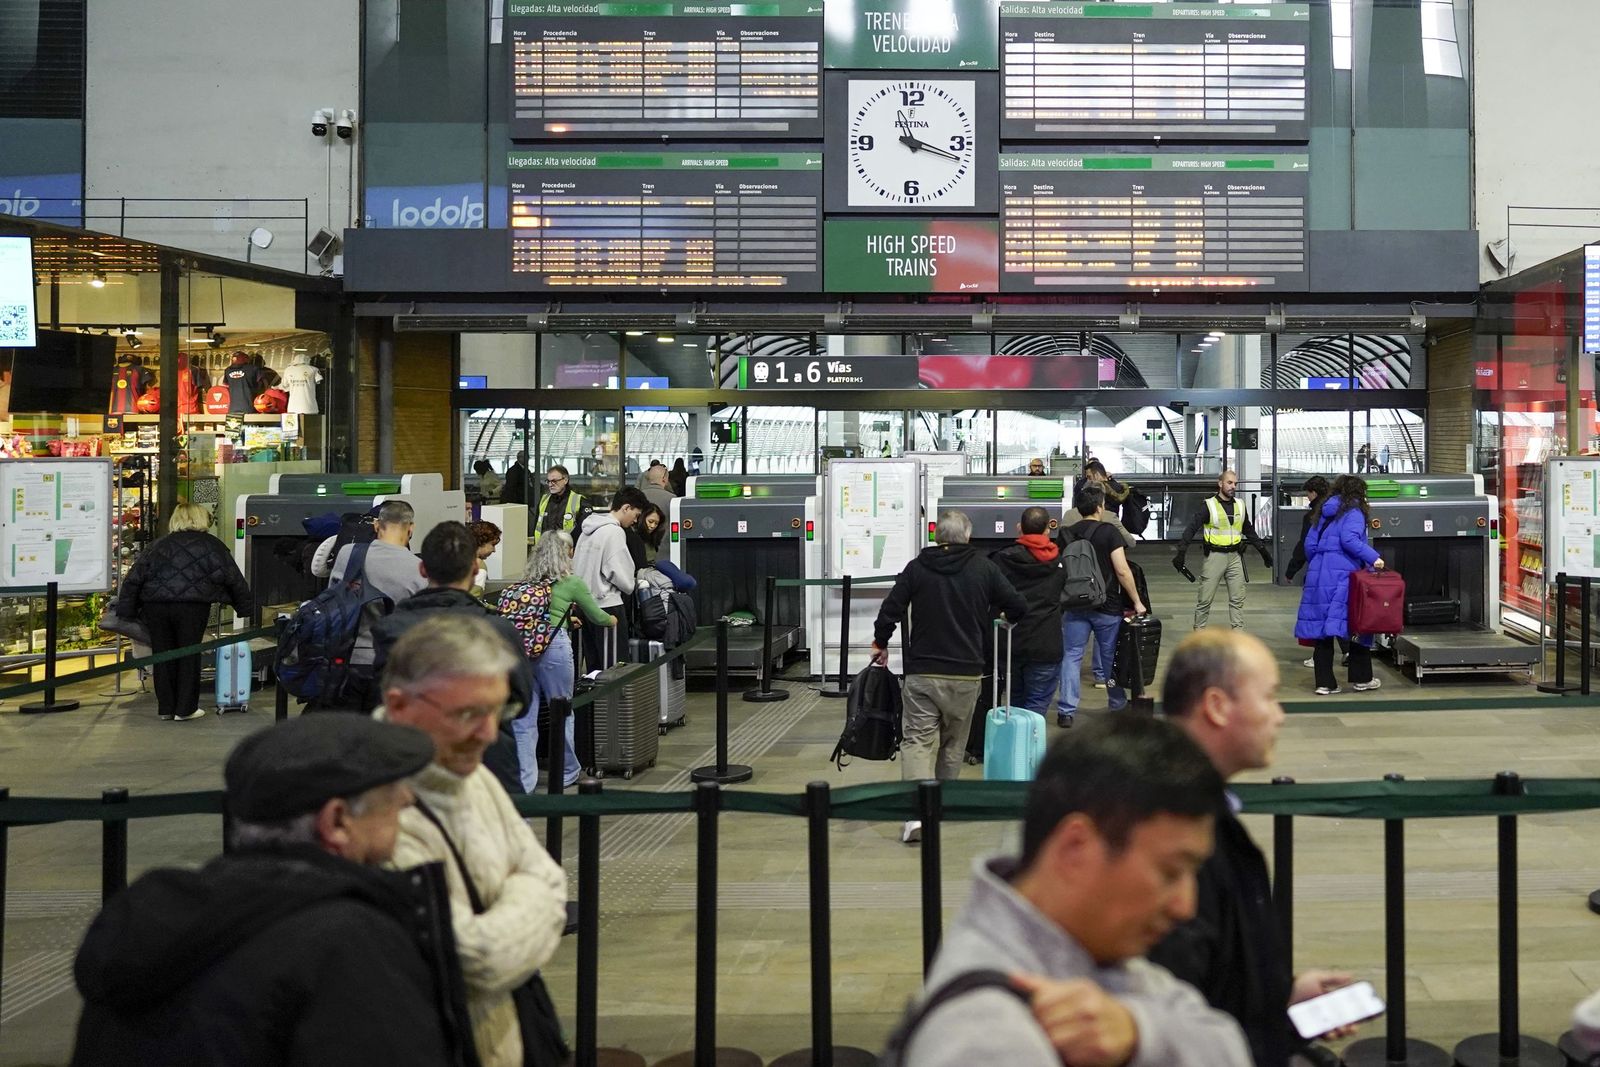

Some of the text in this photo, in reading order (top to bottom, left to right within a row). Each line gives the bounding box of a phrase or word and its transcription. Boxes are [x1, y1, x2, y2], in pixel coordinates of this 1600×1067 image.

[511, 4, 598, 14] Llegadas: Alta velocidad
[1000, 5, 1083, 14] Salidas: Alta velocidad
[865, 12, 914, 30] TRENE
[872, 35, 950, 52] VELOCIDAD
[899, 91, 924, 106] 12
[858, 135, 874, 150] 9
[950, 136, 965, 151] 3
[508, 157, 596, 167] Llegadas: Alta velocidad
[1000, 158, 1083, 167] Salidas: Alta velocidad
[904, 180, 919, 196] 6
[867, 235, 956, 254] HIGH SPEED
[886, 258, 937, 276] TRAINS
[775, 361, 821, 383] 1 a 6
[827, 361, 852, 373] Vías
[712, 432, 719, 442] 4
[1252, 438, 1257, 448] 3
